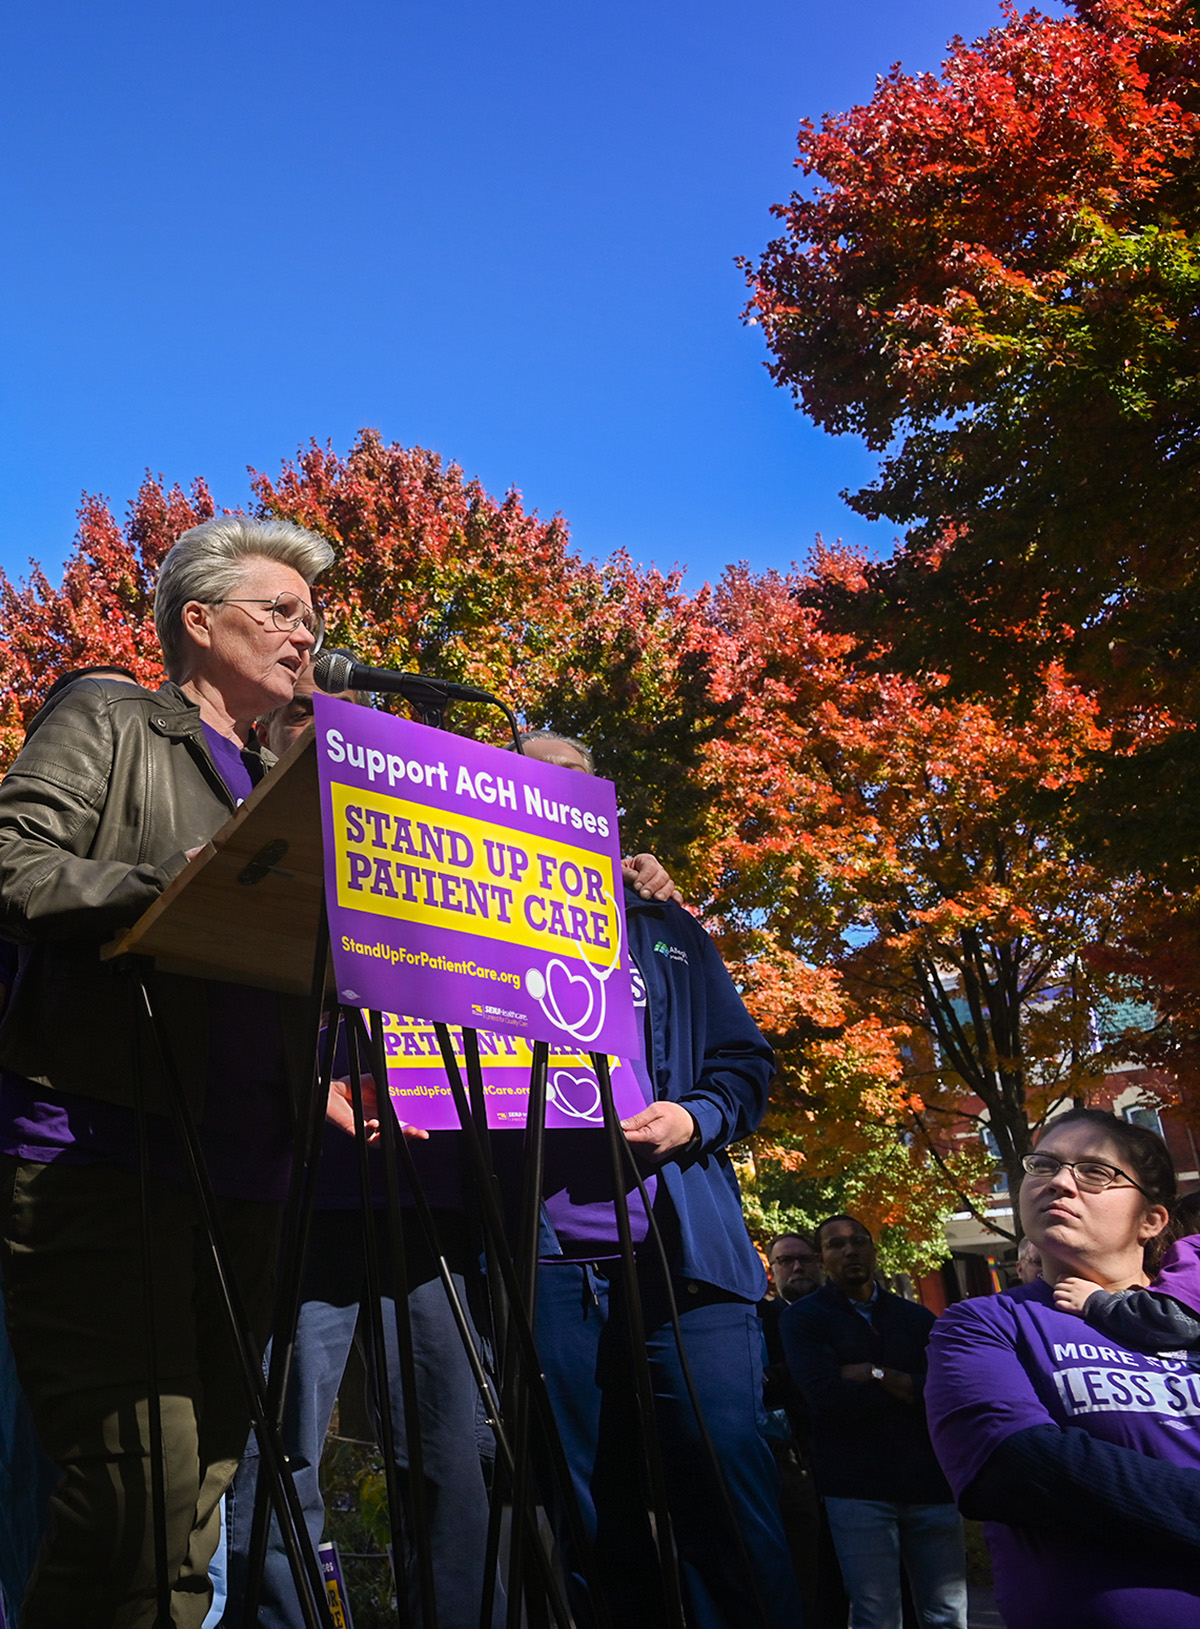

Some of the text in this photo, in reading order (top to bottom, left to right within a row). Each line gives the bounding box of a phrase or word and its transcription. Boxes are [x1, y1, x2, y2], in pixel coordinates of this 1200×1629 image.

[325, 728, 610, 838] Support AGH Nurses
[345, 805, 608, 905] STAND UP FOR
[346, 851, 611, 949] PATIENT CARE
[341, 935, 521, 990] StandUpForPatientCare.org
[384, 1032, 518, 1055] PATNT
[1053, 1343, 1139, 1367] MORE
[1062, 1370, 1156, 1408] LESS
